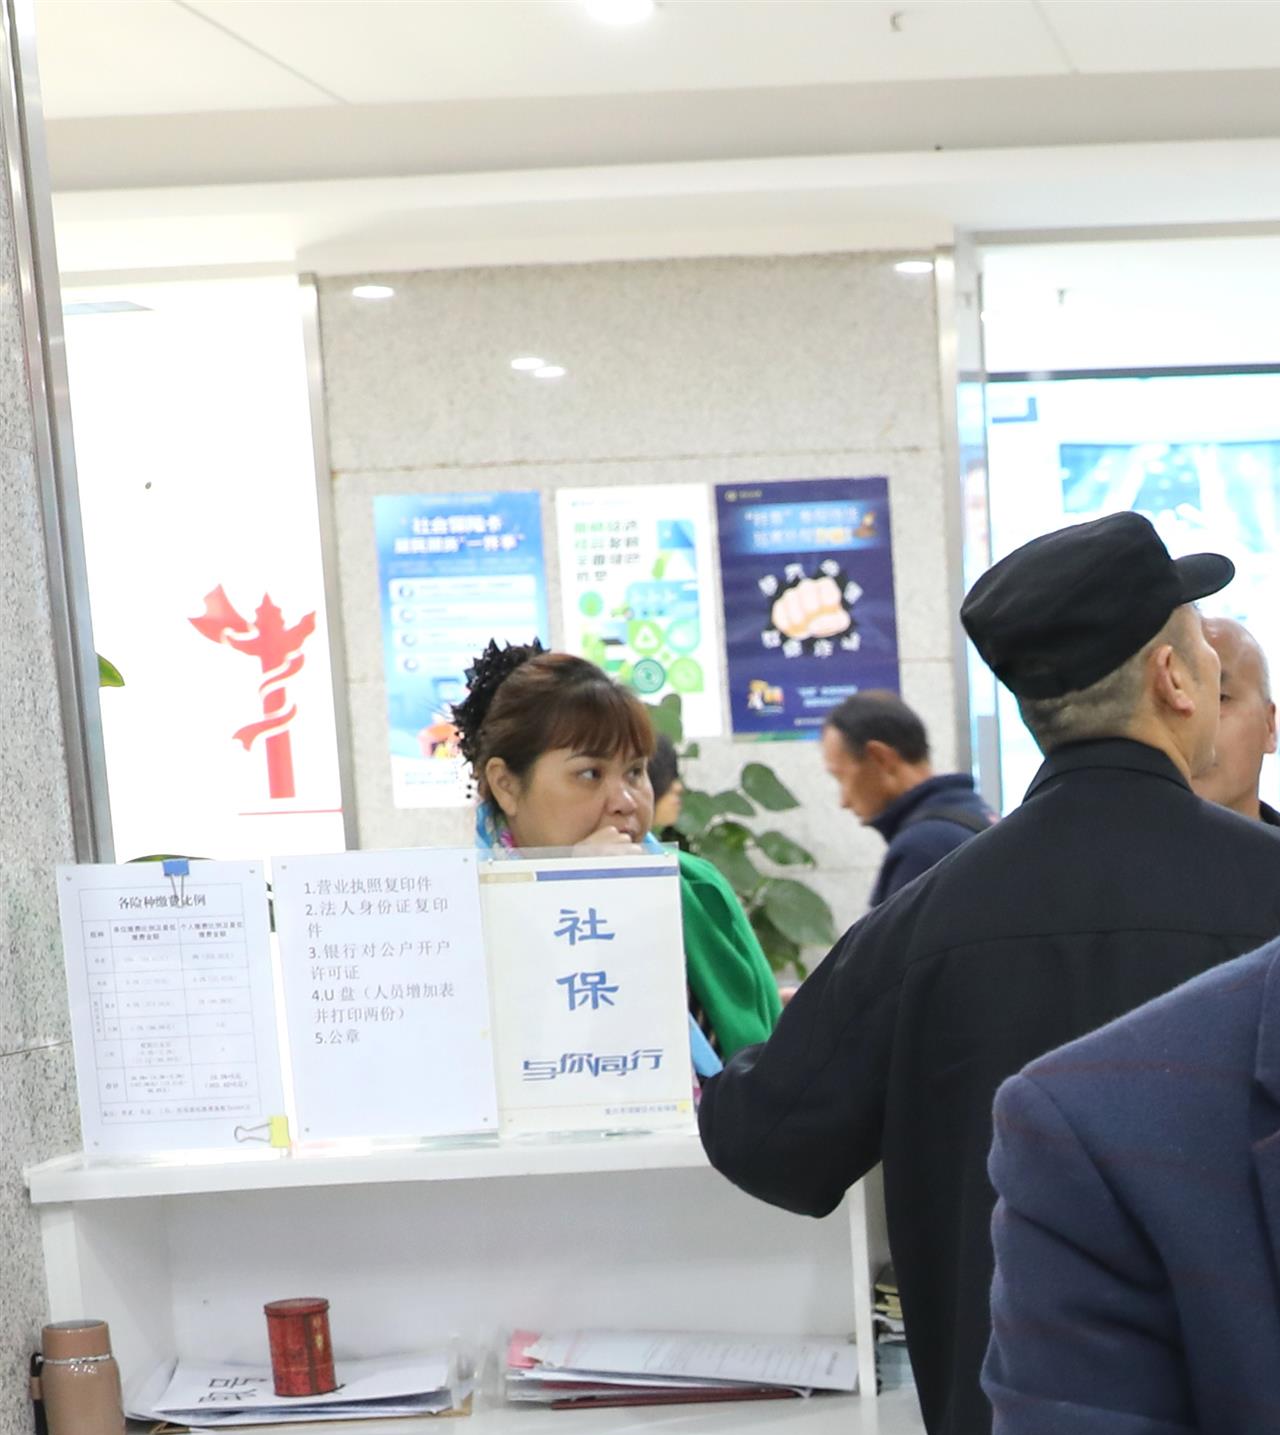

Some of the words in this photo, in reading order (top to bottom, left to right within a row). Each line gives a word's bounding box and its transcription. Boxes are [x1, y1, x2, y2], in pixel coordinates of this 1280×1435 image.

[304, 876, 432, 895] 1.营业执照复印件
[311, 965, 360, 981] 许可证
[315, 1028, 360, 1044] 5.公章
[522, 1049, 664, 1082] 与你同行
